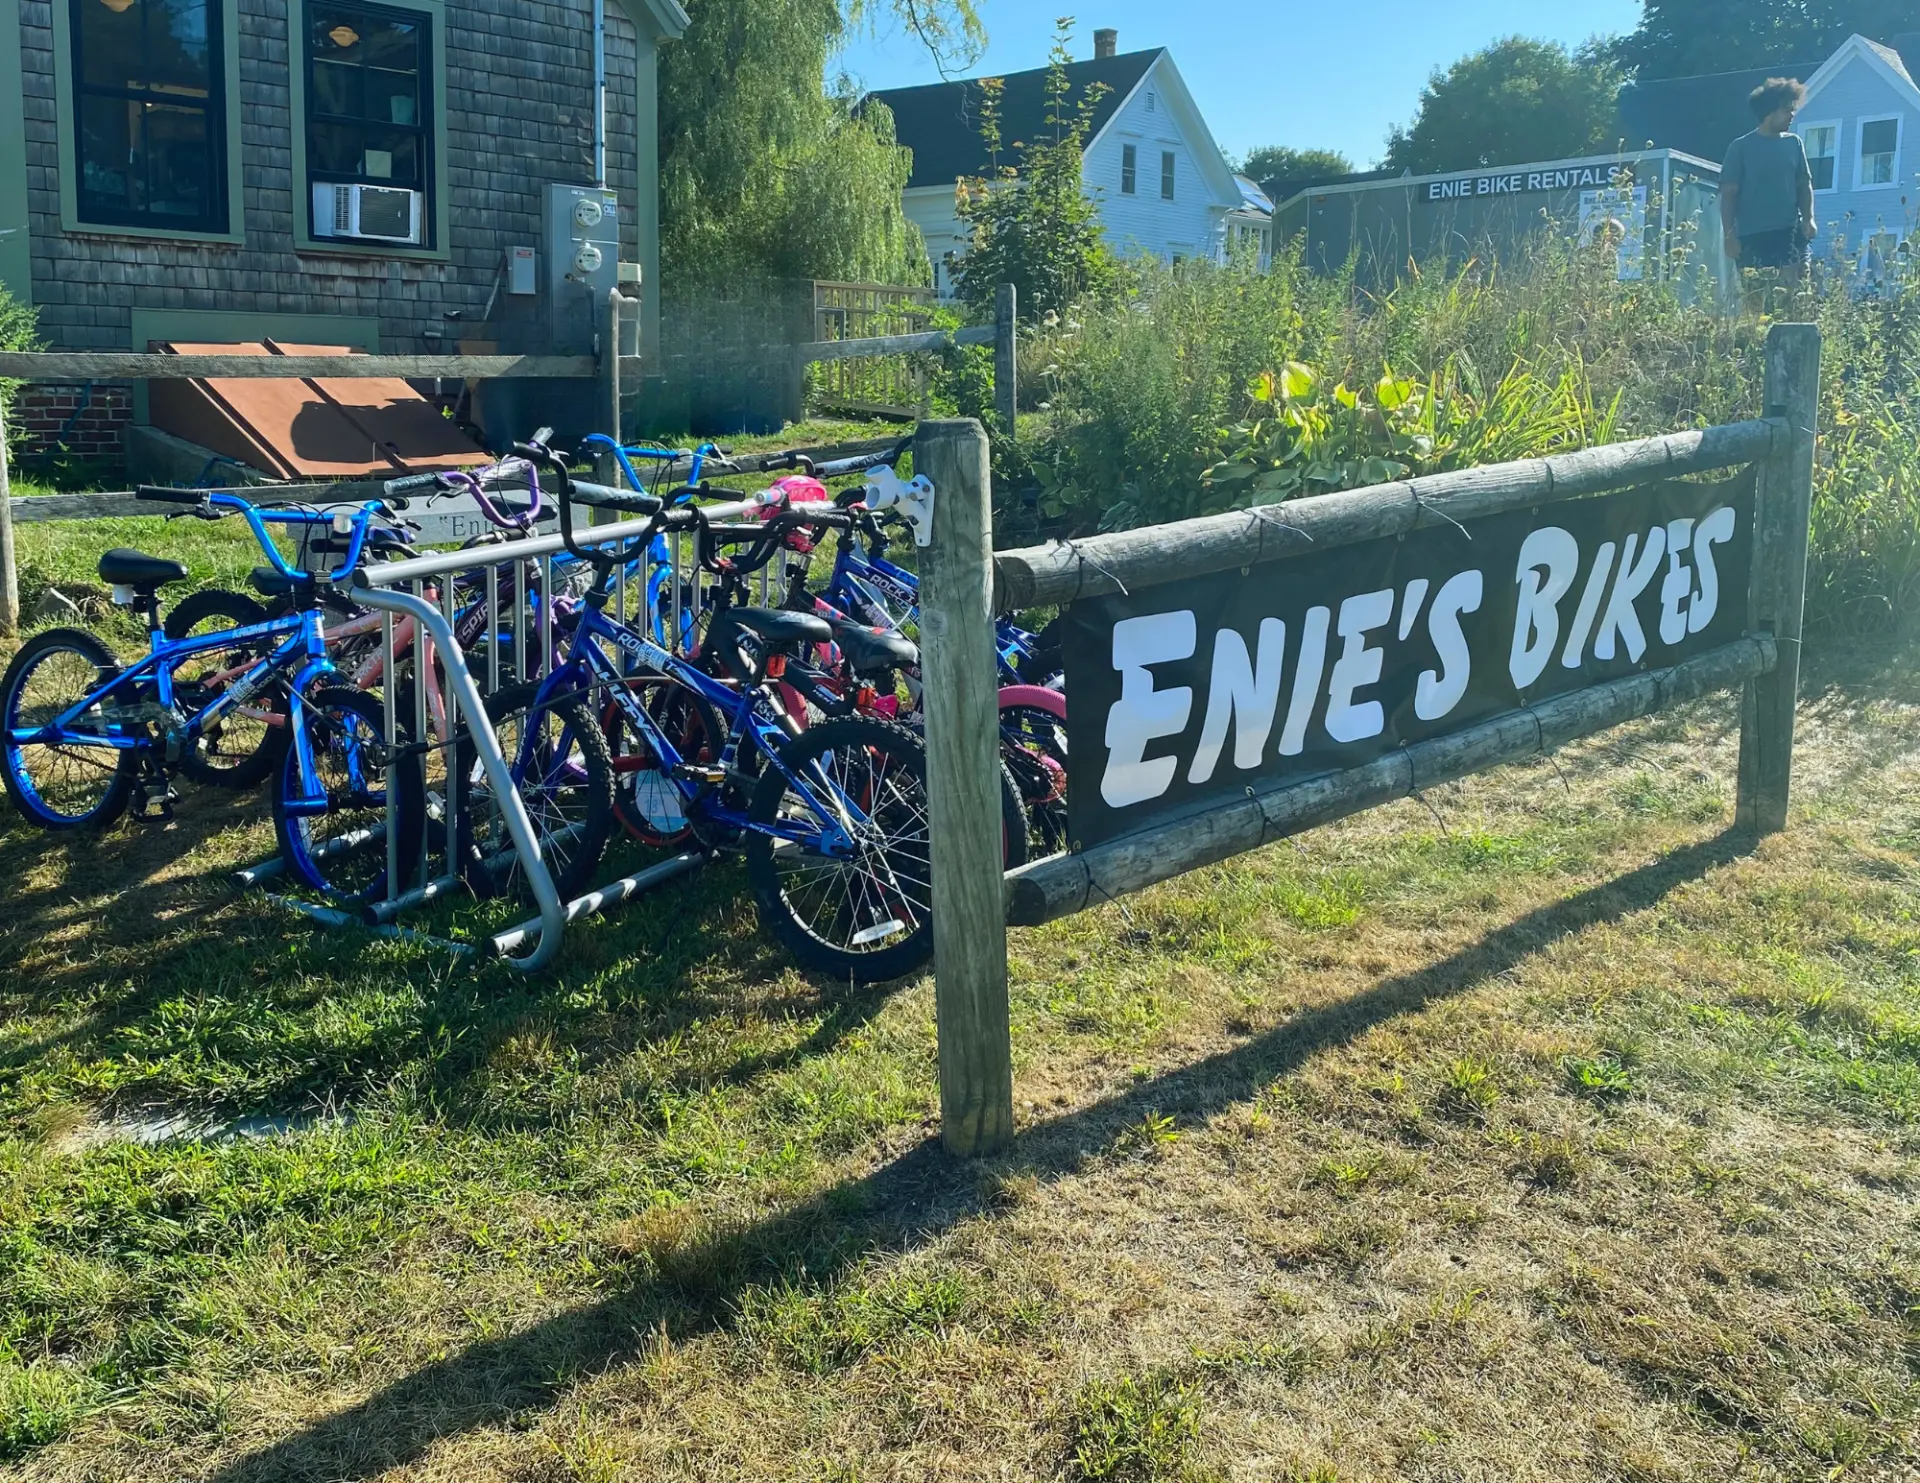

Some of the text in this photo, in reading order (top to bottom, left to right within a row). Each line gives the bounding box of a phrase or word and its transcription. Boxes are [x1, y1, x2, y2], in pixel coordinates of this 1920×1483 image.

[1429, 166, 1621, 199] ENIE BIKE RENTALS
[870, 573, 905, 598] ROCK
[1100, 506, 1736, 808] ENIE'S BIKES
